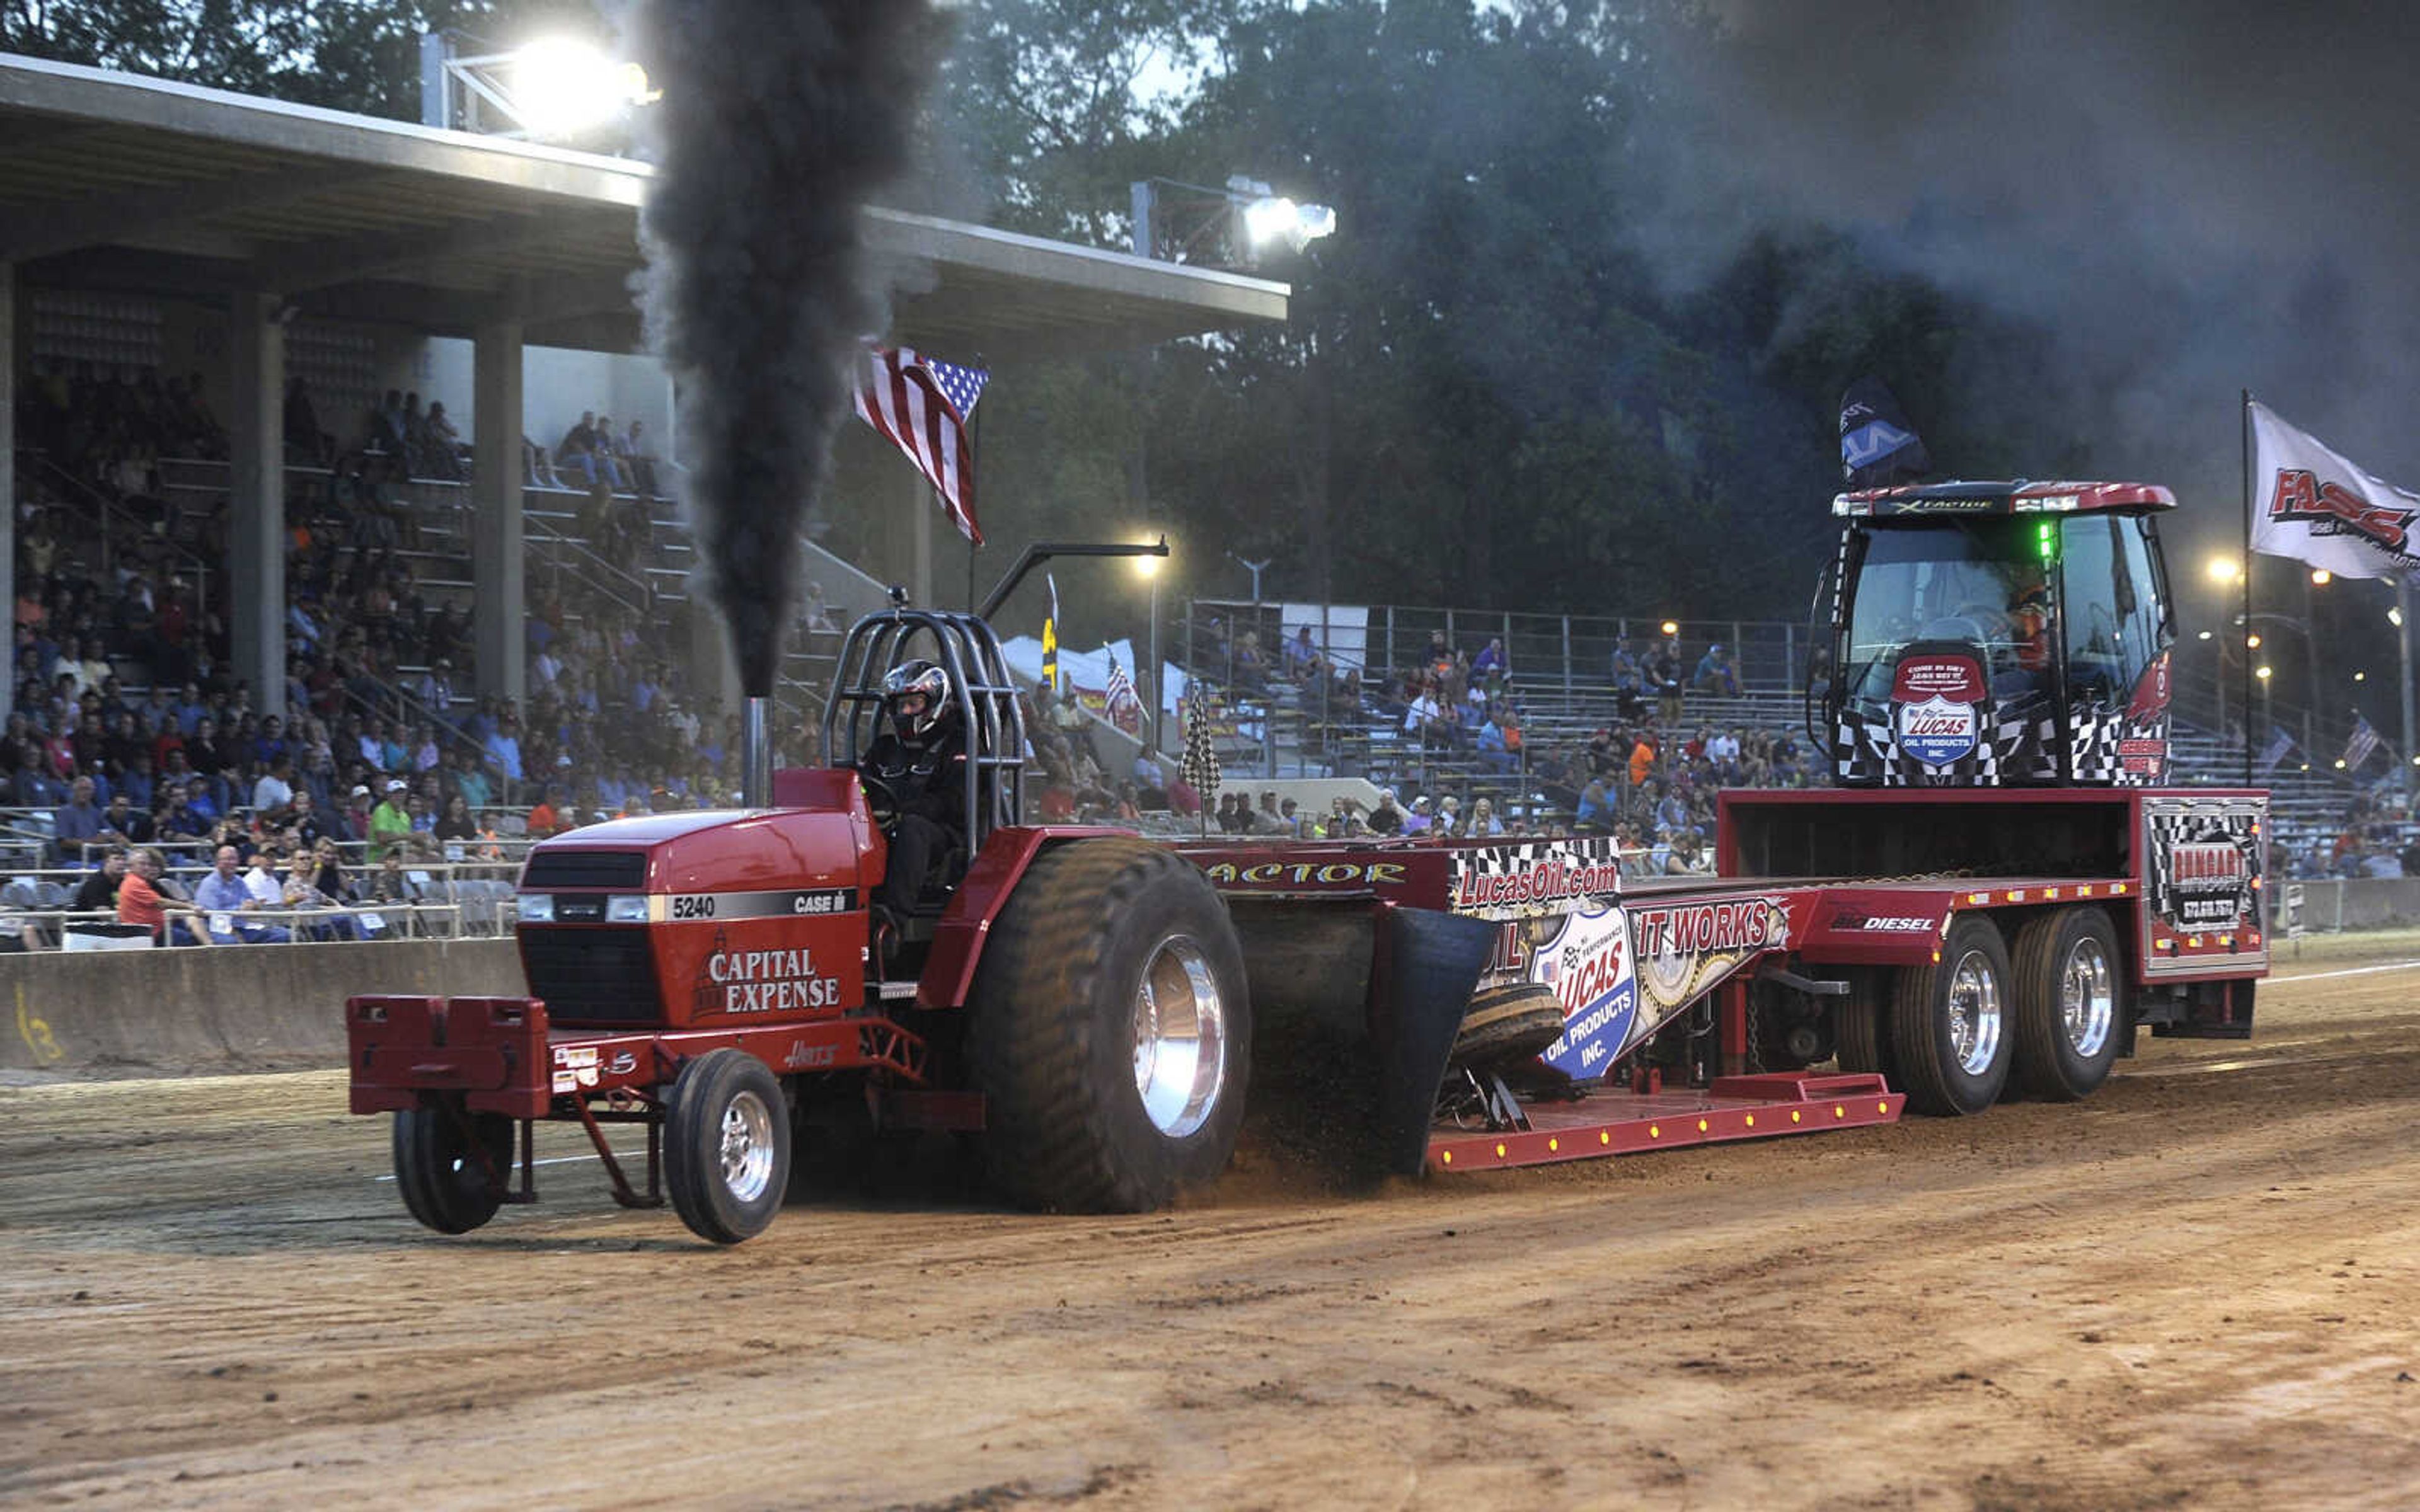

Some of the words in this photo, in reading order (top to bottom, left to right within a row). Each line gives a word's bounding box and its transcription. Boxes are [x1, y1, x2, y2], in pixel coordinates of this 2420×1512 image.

[1908, 718, 1968, 735] LUCAS
[1206, 862, 1408, 883] ACTOR
[1458, 860, 1618, 907] LucasOil.com
[673, 896, 715, 918] 5240
[794, 895, 831, 913] CASE
[1639, 911, 1668, 956] IT
[1673, 900, 1768, 953] WORKS
[1547, 1036, 1568, 1061] OIL
[1569, 990, 1632, 1046] PRODUCTS
[1581, 1040, 1606, 1067] INC.
